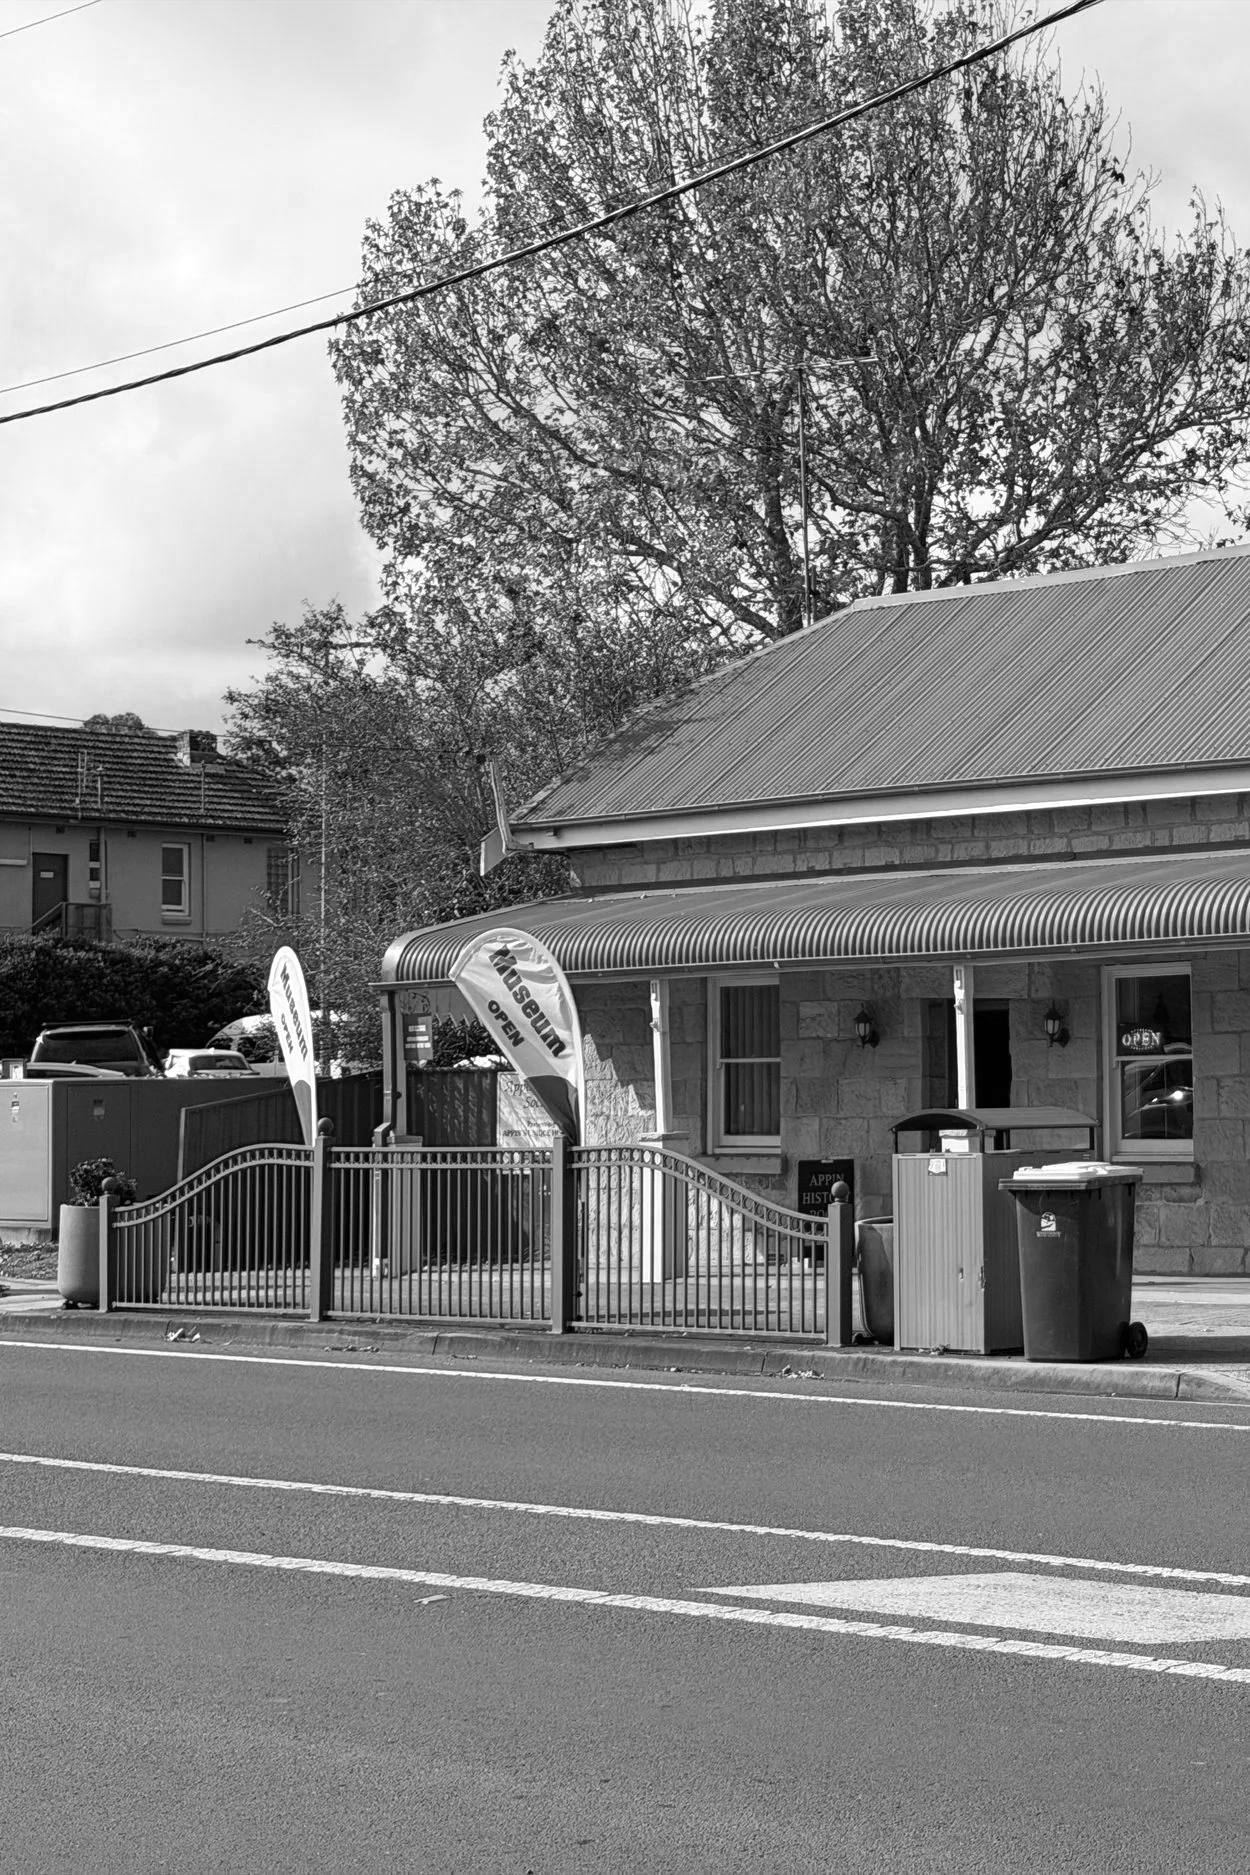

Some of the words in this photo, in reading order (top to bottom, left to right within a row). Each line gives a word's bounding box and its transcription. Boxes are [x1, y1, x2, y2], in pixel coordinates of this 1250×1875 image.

[280, 961, 308, 1062] Museum
[488, 944, 566, 1058] Museum
[281, 1013, 293, 1055] OPEN
[487, 1000, 525, 1047] OPEN
[1121, 1031, 1161, 1047] OPEN
[802, 1191, 851, 1204] HISTY
